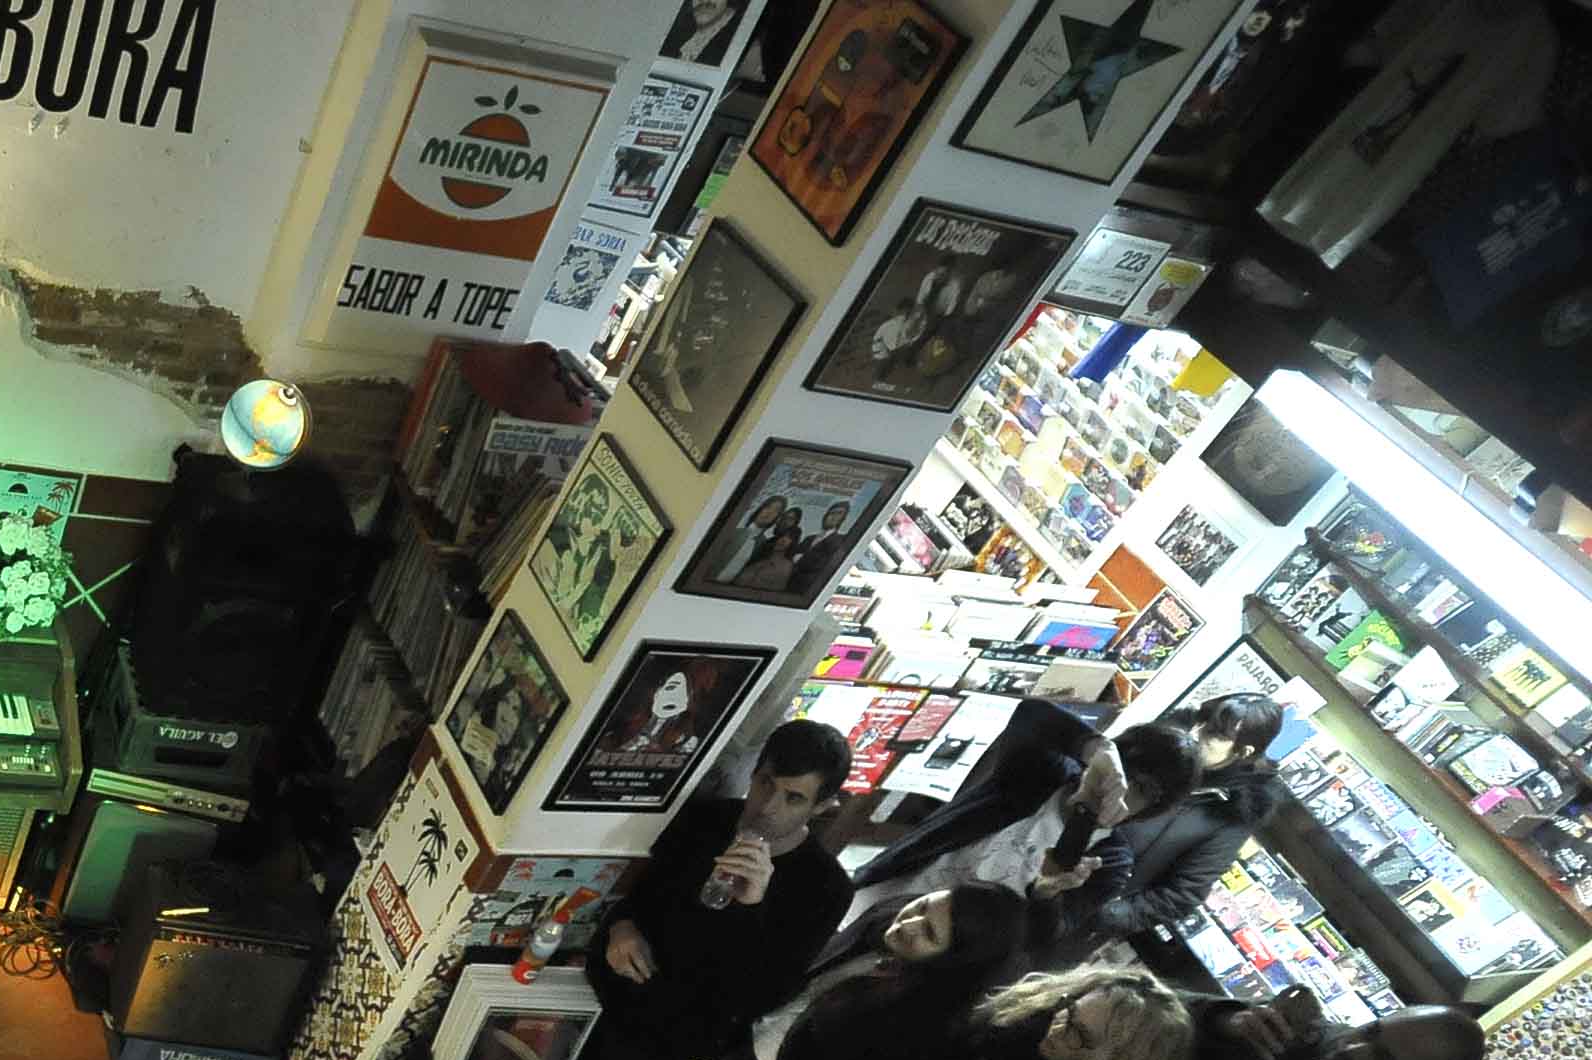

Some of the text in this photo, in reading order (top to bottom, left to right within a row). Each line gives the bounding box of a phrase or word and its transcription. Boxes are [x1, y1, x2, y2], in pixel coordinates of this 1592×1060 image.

[419, 137, 548, 183] MIRINDA
[1115, 250, 1152, 273] 223
[337, 264, 520, 331] SABOR A TOPE
